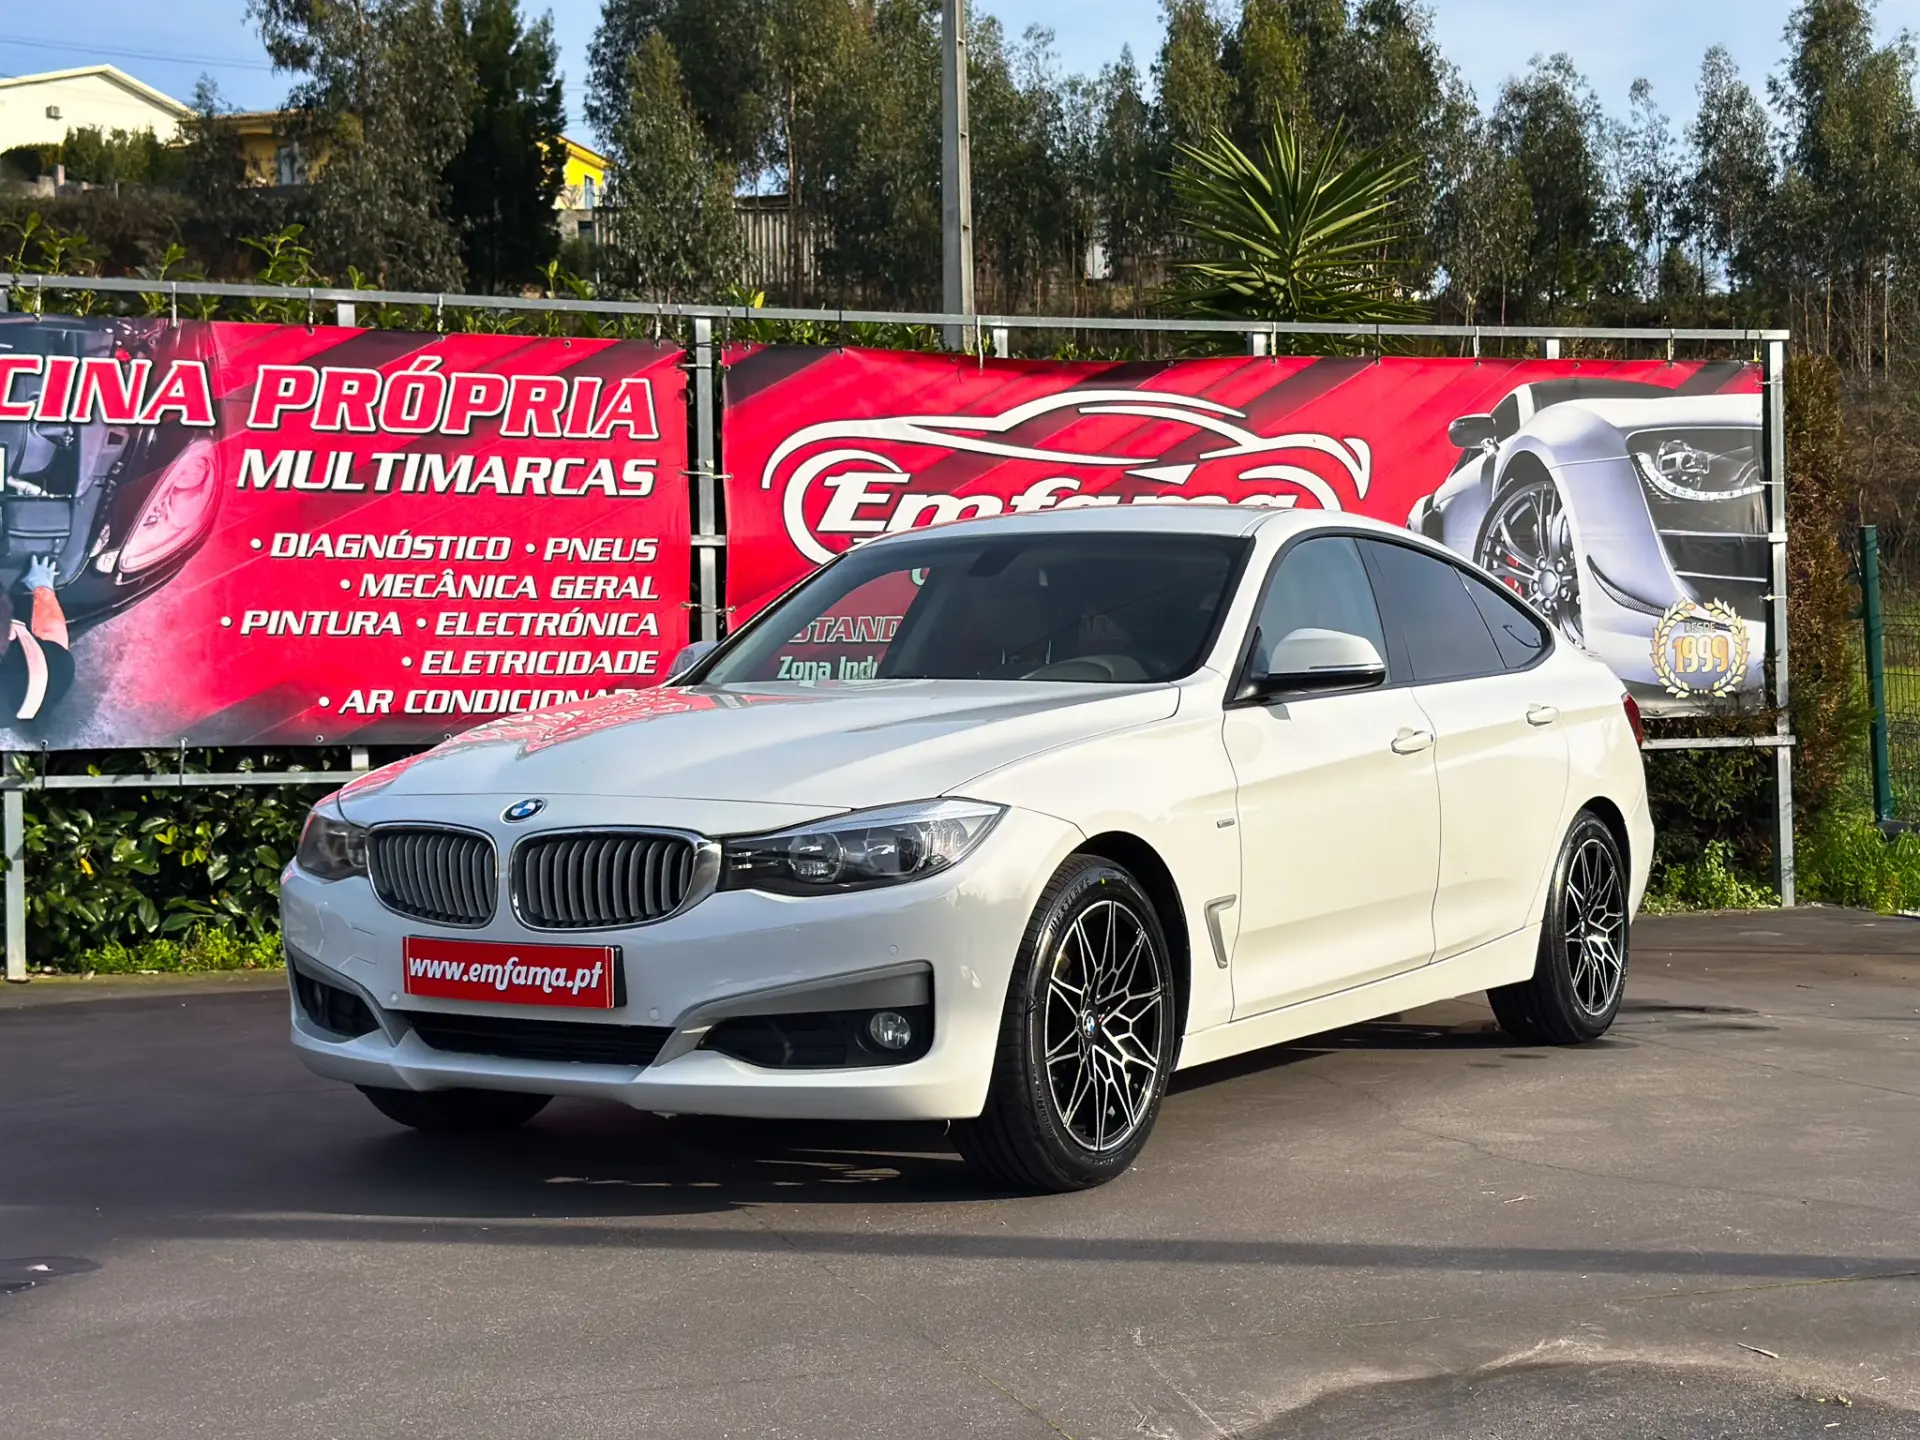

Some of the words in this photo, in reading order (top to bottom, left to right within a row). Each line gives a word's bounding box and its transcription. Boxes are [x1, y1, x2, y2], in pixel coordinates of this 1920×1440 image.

[247, 355, 660, 440] PRÓPRIA
[237, 448, 657, 497] MULTIMARCAS
[270, 529, 512, 562] DIAGNÓSTICO
[543, 537, 659, 563] PNEUS
[358, 568, 539, 599] MECÂNICA
[550, 575, 658, 601] GERAL
[239, 611, 402, 637] PINTURA
[435, 604, 659, 638] ELECTRÓNICA
[420, 649, 658, 676] ELETRICIDADE
[777, 655, 832, 682] Zona
[1672, 634, 1729, 673] 1999
[338, 689, 394, 715] AR
[408, 956, 603, 996] www.emfama.pt
